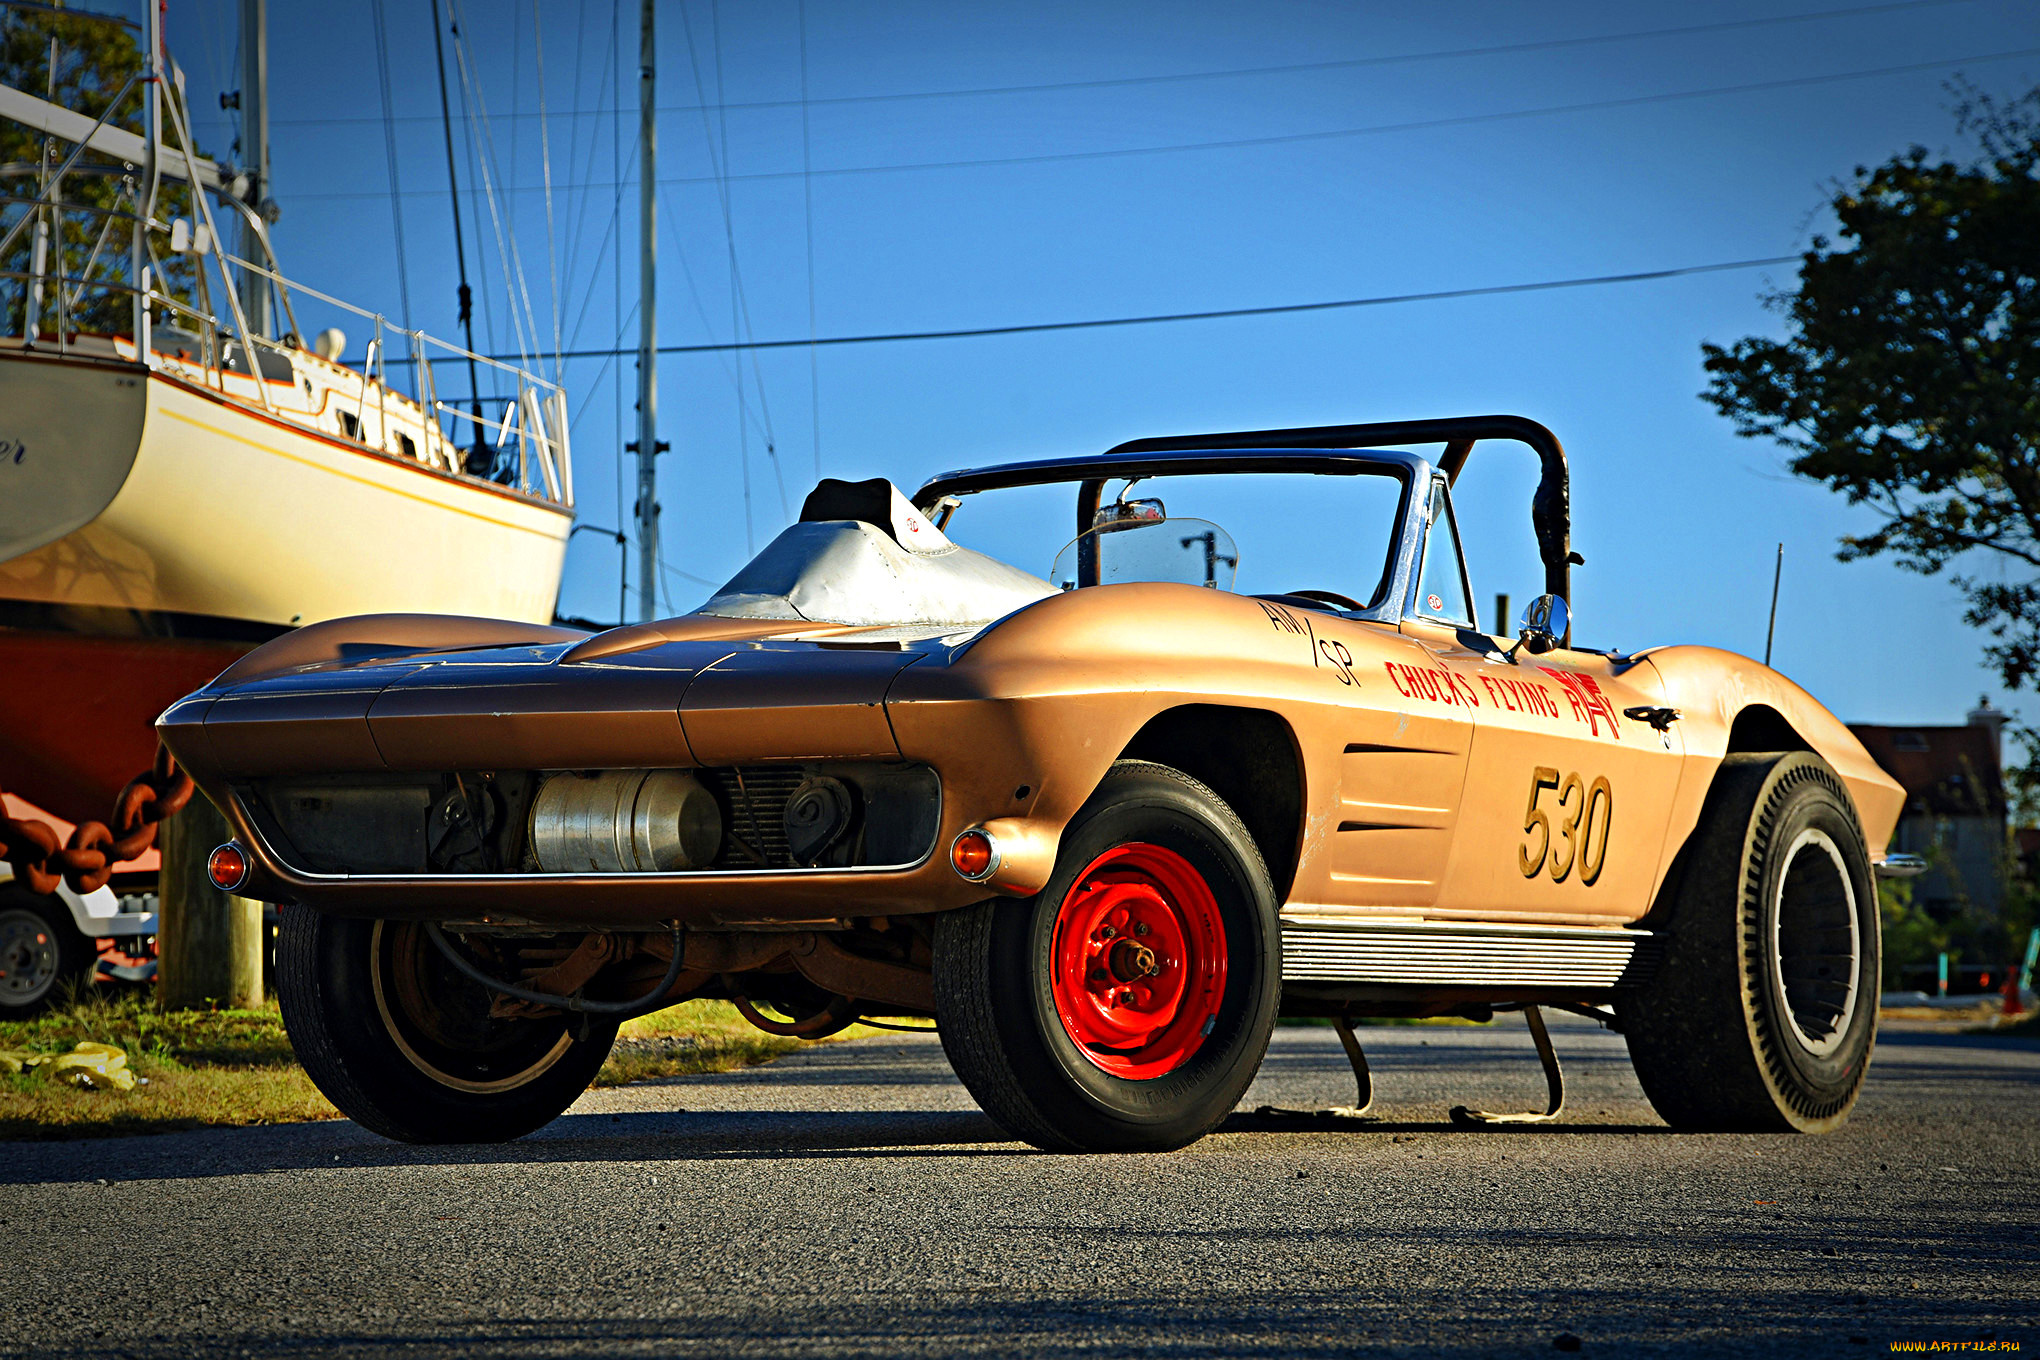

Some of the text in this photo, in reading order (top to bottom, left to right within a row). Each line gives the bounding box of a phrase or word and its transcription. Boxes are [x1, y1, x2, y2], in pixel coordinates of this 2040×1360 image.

[1384, 661, 1620, 740] CHUCK'S FLYING RAY
[1519, 765, 1613, 888] 530
